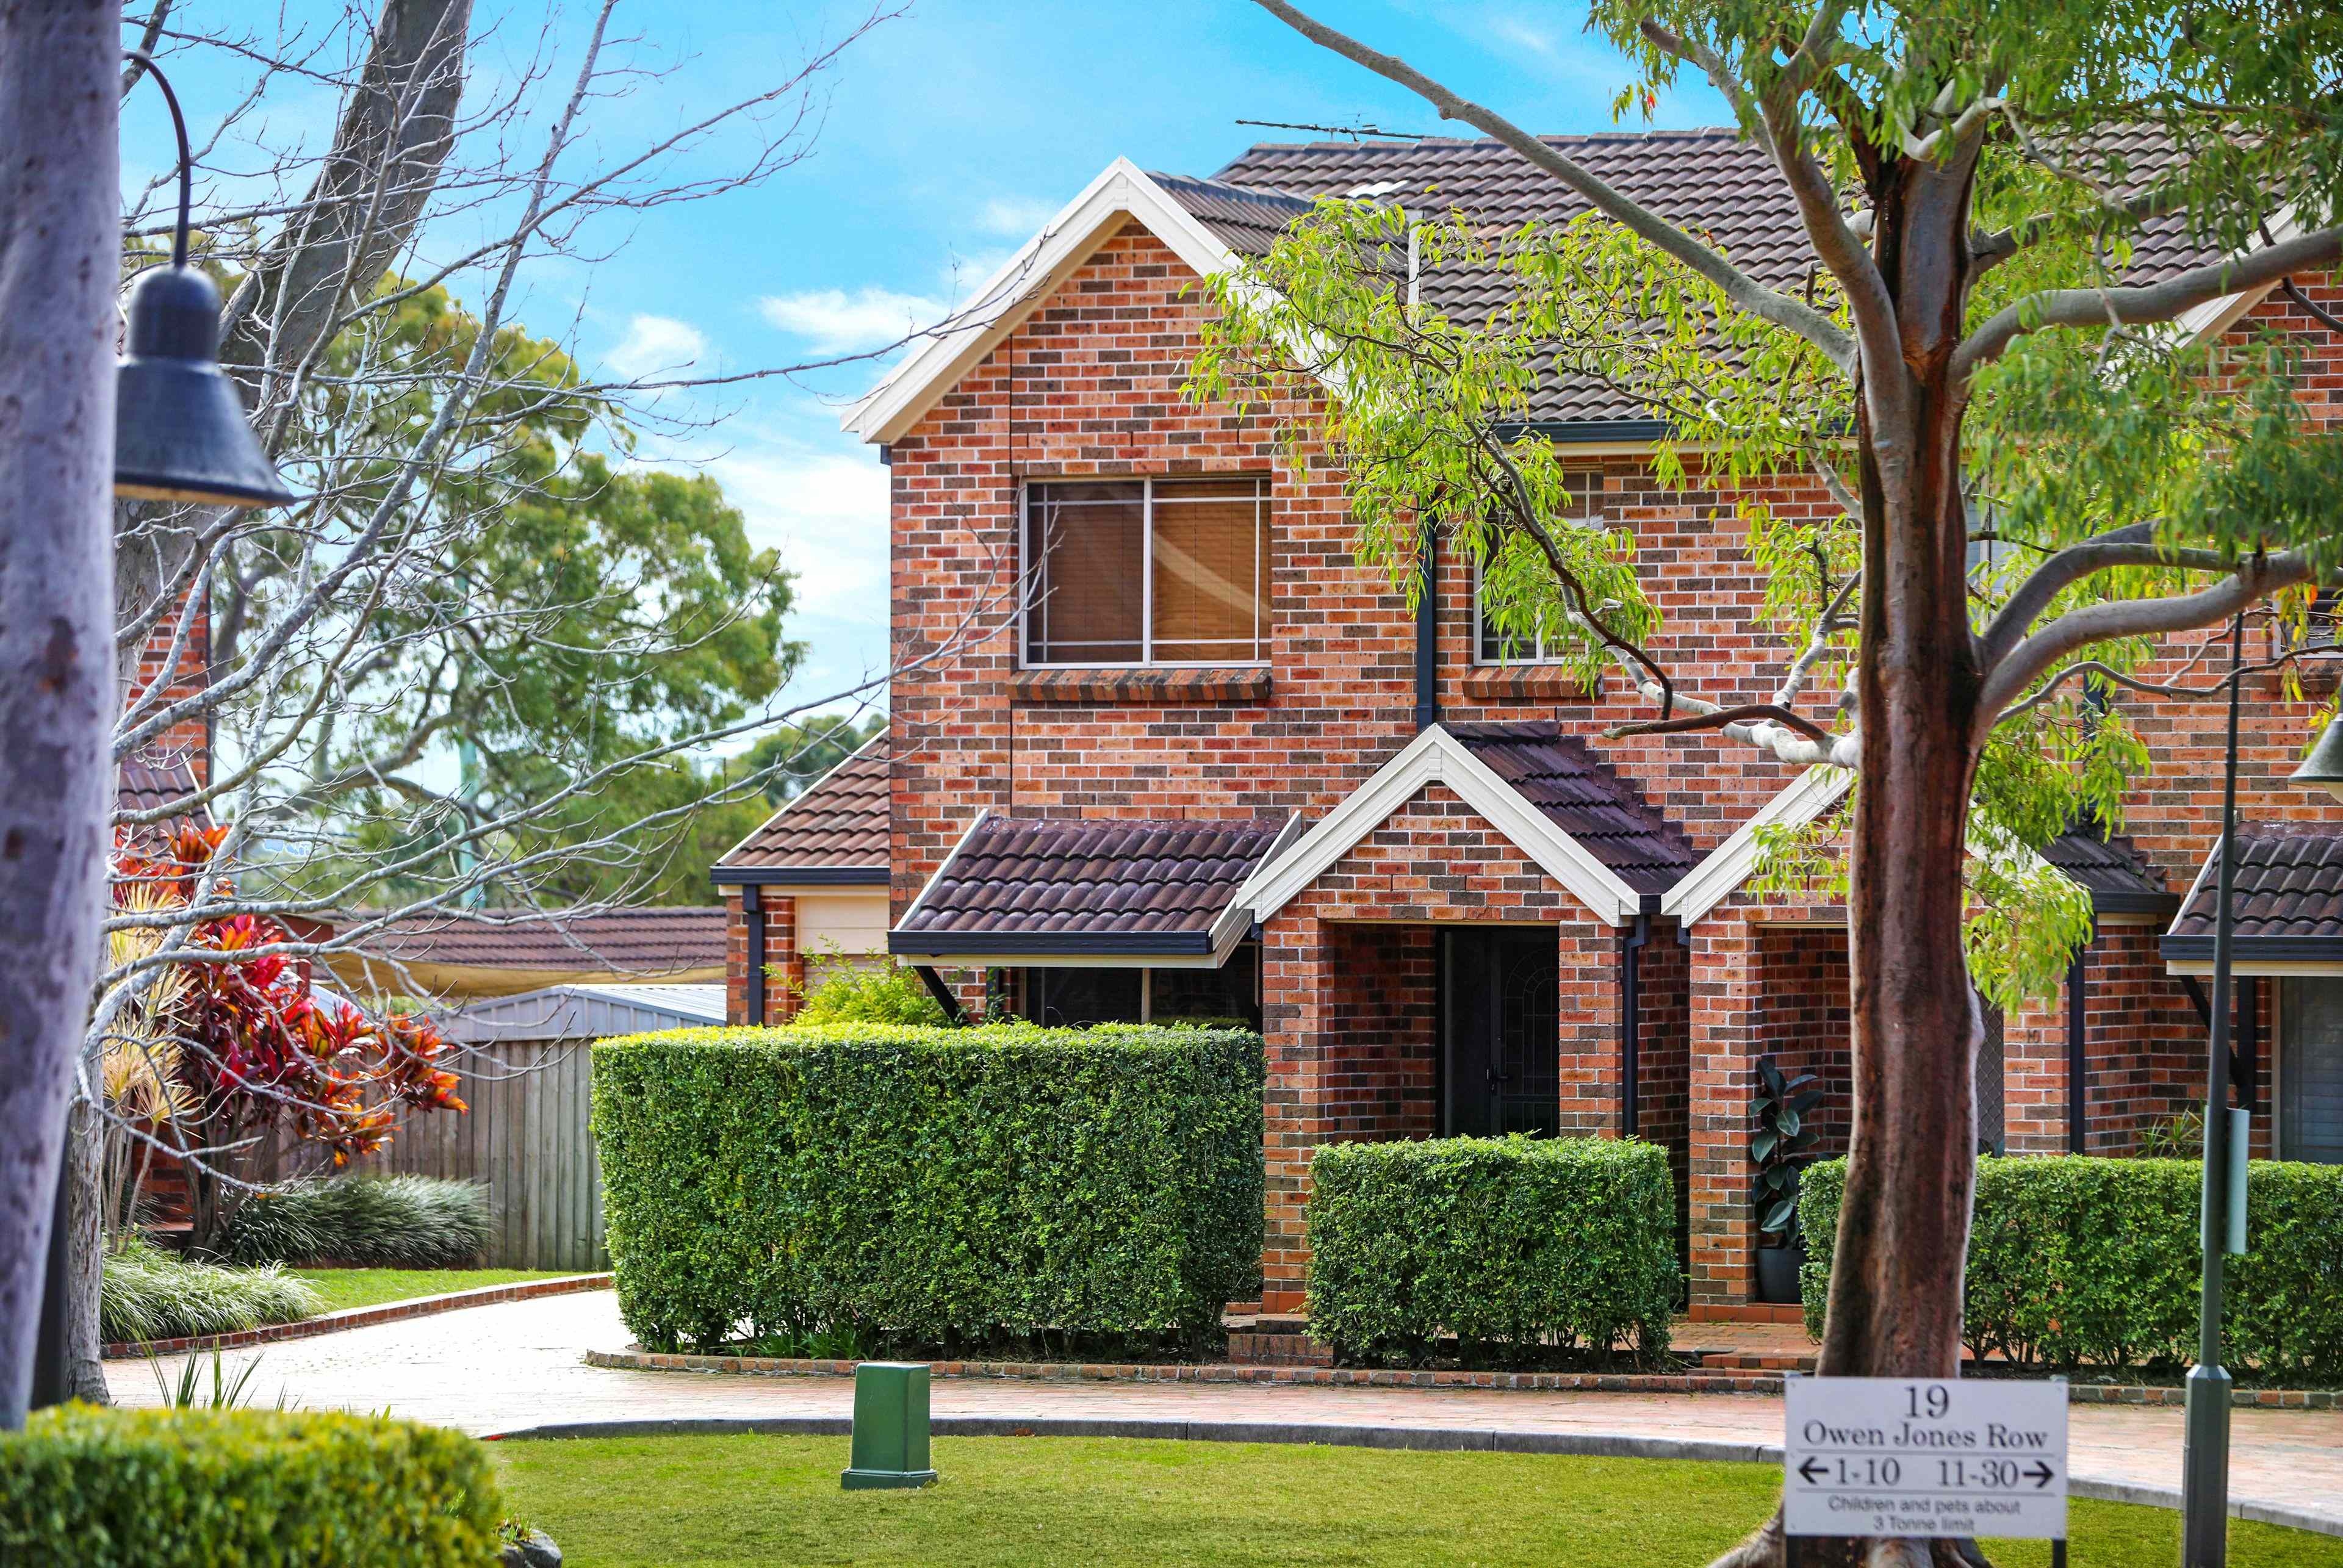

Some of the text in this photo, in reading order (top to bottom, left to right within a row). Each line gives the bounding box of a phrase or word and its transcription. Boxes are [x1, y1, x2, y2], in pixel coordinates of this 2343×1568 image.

[1904, 1384, 1949, 1419] 19
[1804, 1420, 2048, 1448] Owen Jones Row
[1836, 1458, 1901, 1486] 1-10
[1937, 1459, 2018, 1487] 11-30
[1828, 1495, 2021, 1517] Children and pets about
[1874, 1517, 1974, 1533] 3 Tonne limit
